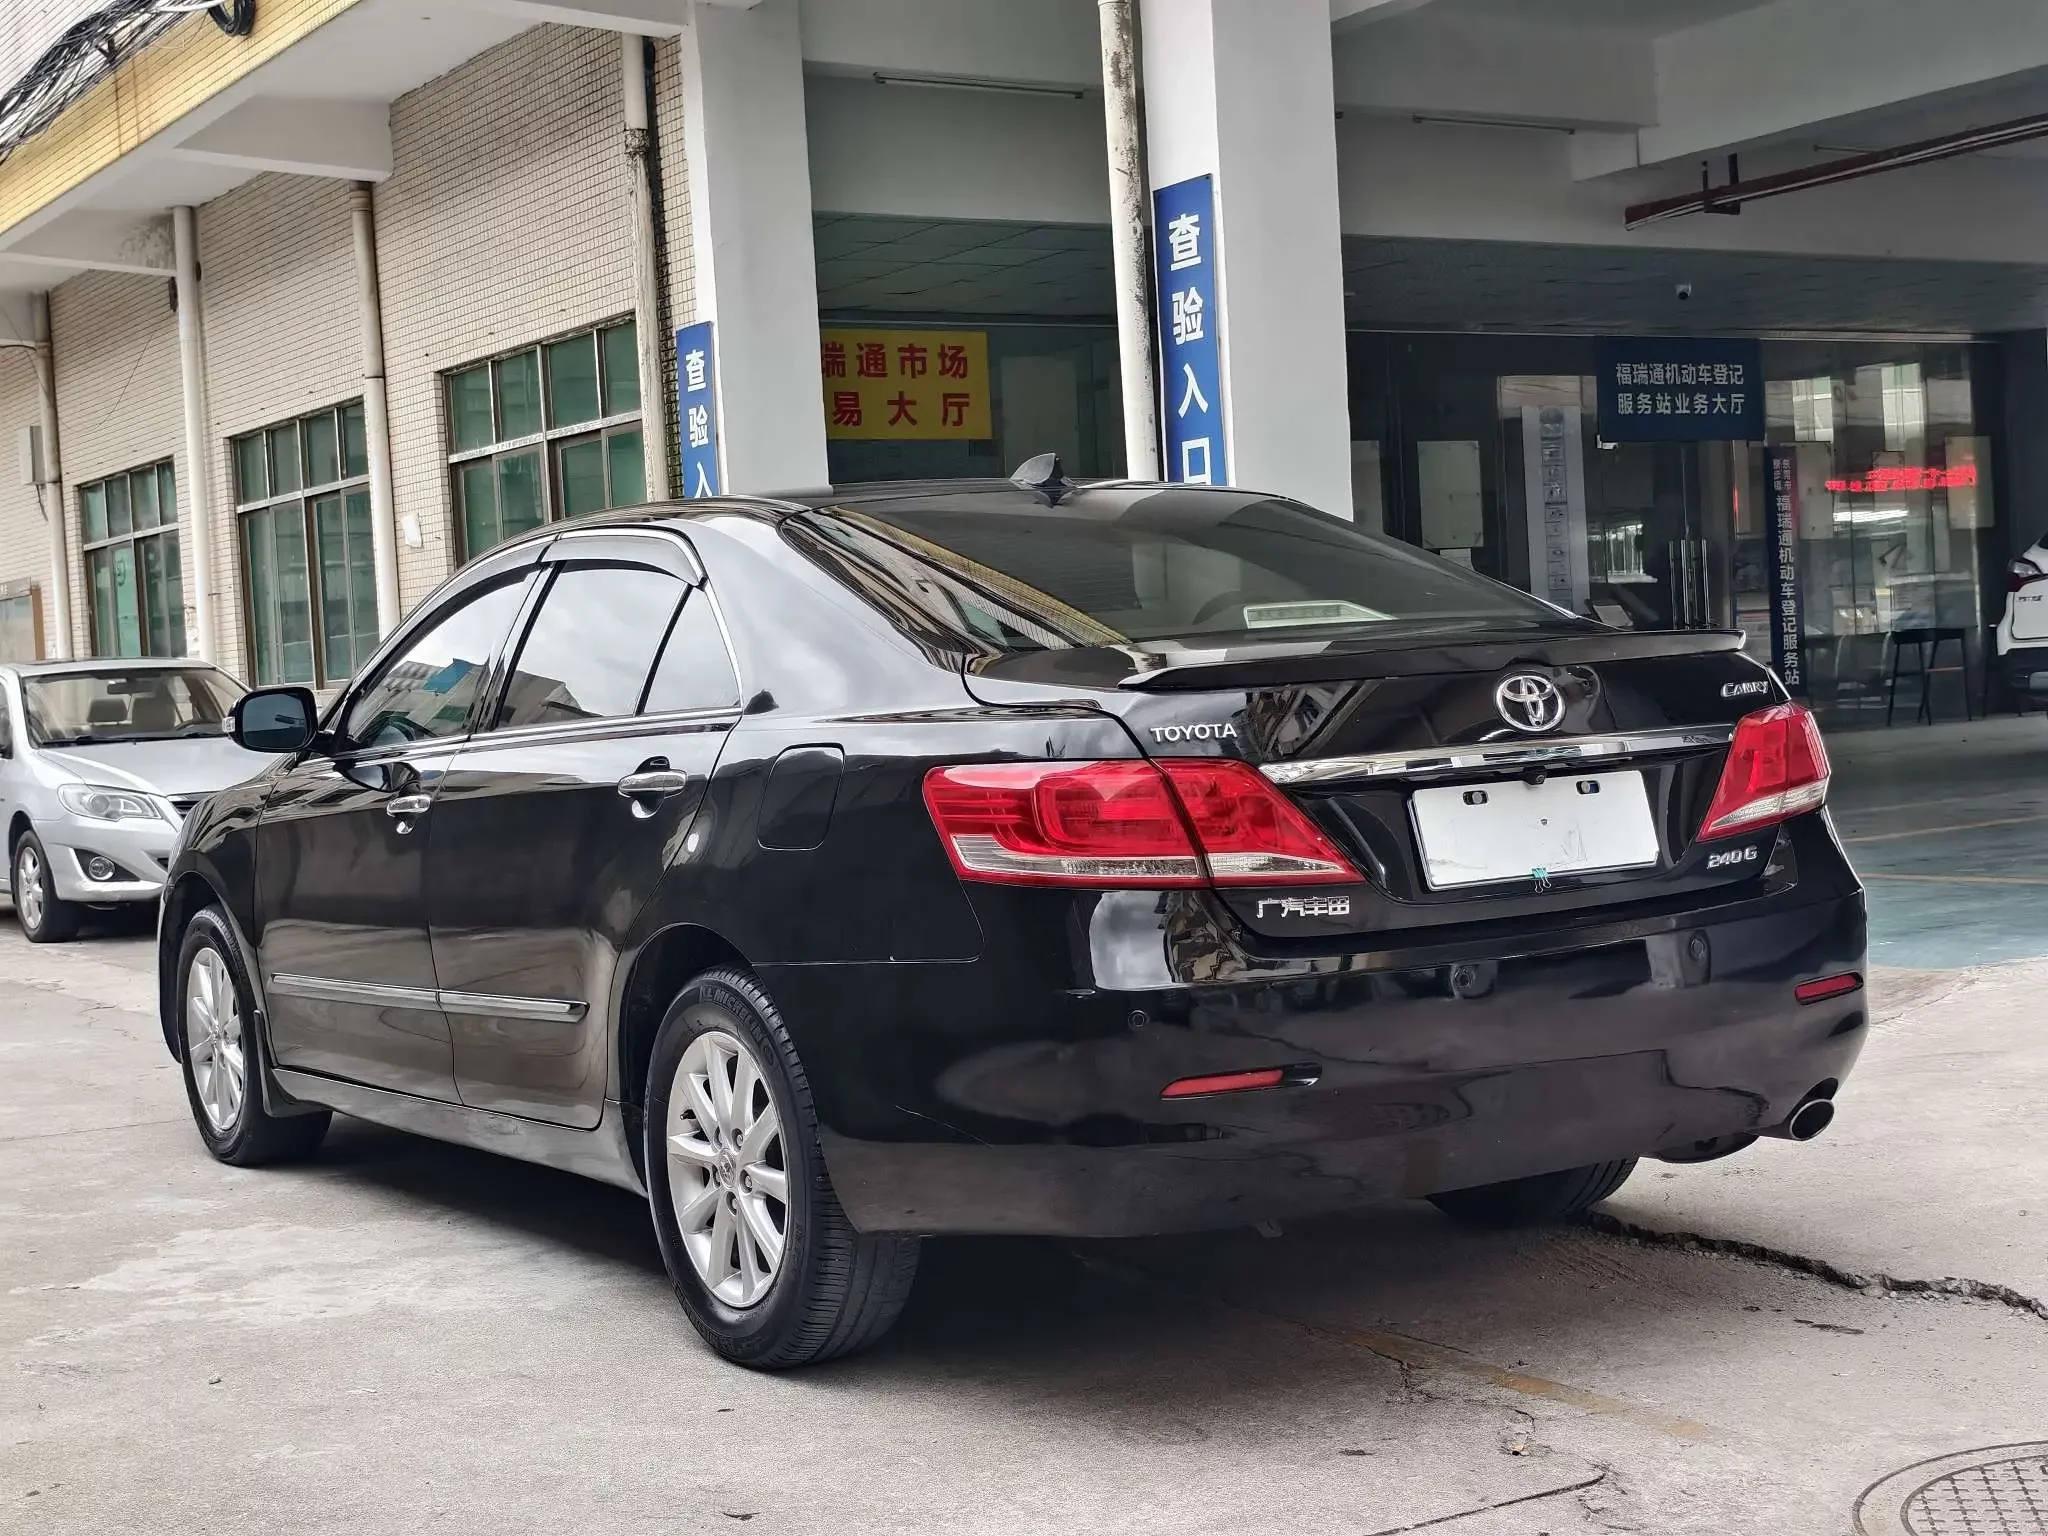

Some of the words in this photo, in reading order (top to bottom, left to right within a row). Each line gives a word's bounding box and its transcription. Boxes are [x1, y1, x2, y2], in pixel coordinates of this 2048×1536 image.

[821, 341, 968, 379] 瑞通市场
[1167, 213, 1212, 486] 查验入口
[1615, 362, 1745, 386] 福瑞通机动车登记
[832, 390, 971, 427] 易大厅
[1617, 392, 1745, 415] 服务站业务大厅
[685, 349, 713, 498] 查验入
[1776, 494, 1800, 686] 福瑞通机动车登记服务站
[1720, 681, 1769, 698] CAMRY
[1150, 723, 1238, 743] TOYOTA
